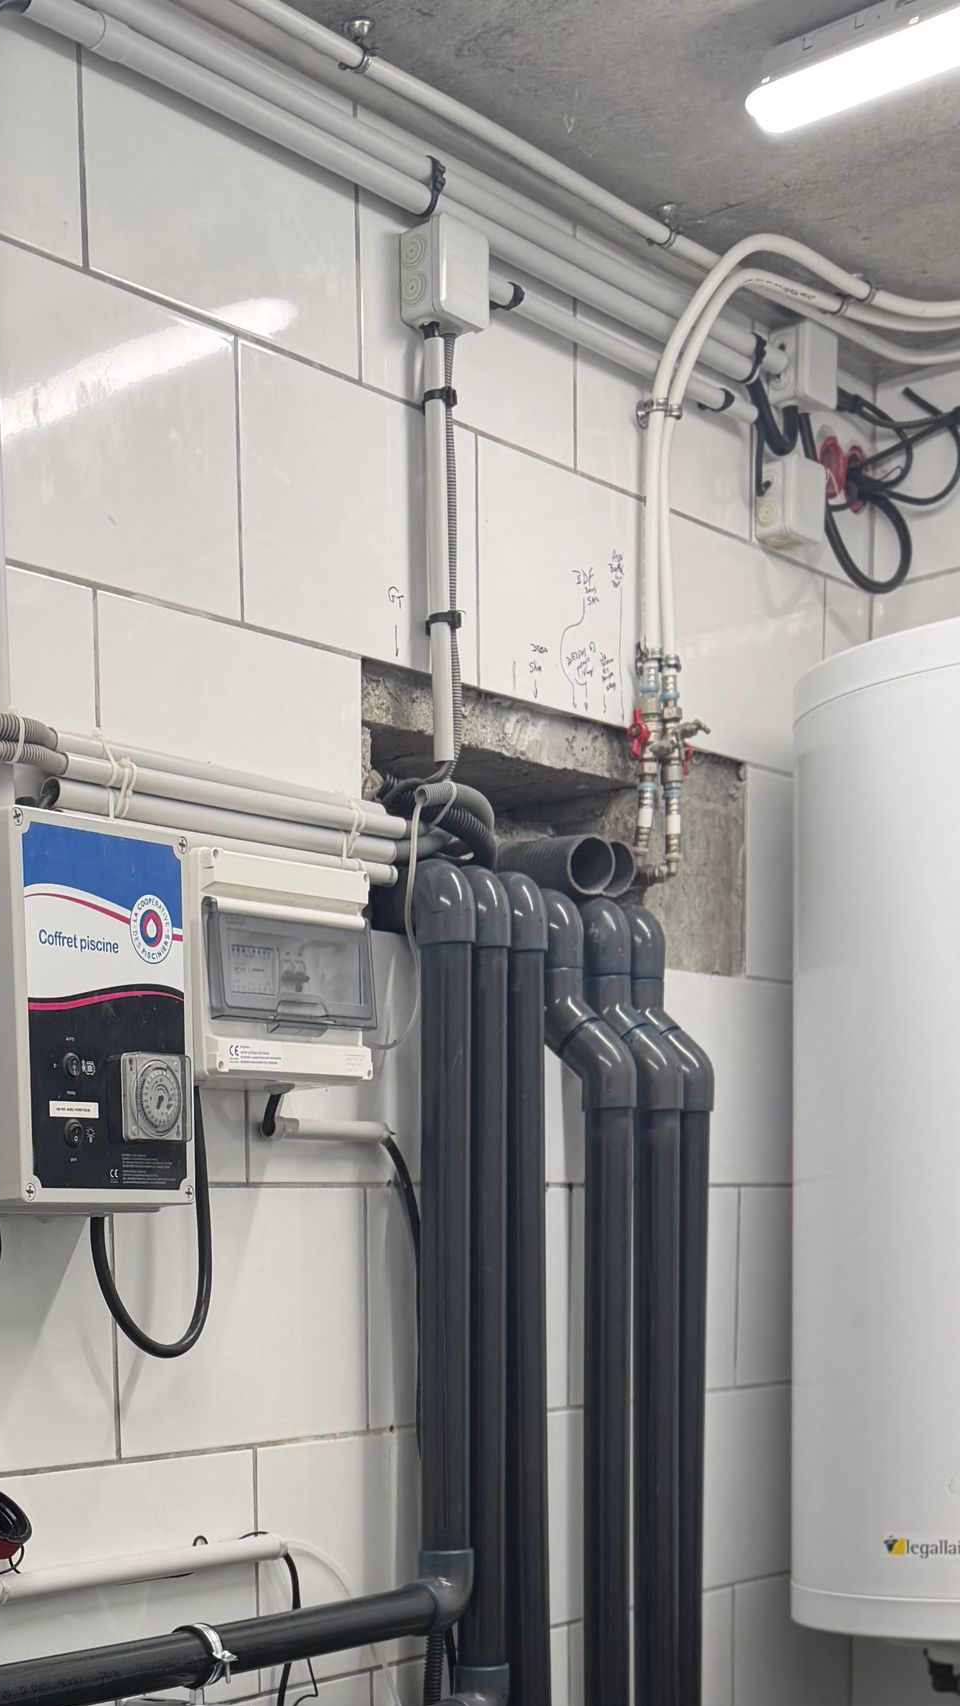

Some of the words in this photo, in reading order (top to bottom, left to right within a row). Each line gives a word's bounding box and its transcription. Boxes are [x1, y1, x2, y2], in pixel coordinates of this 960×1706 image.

[133, 911, 139, 923] LA
[38, 929, 78, 949] Coffret
[80, 936, 119, 954] piscine
[132, 931, 142, 949] DES
